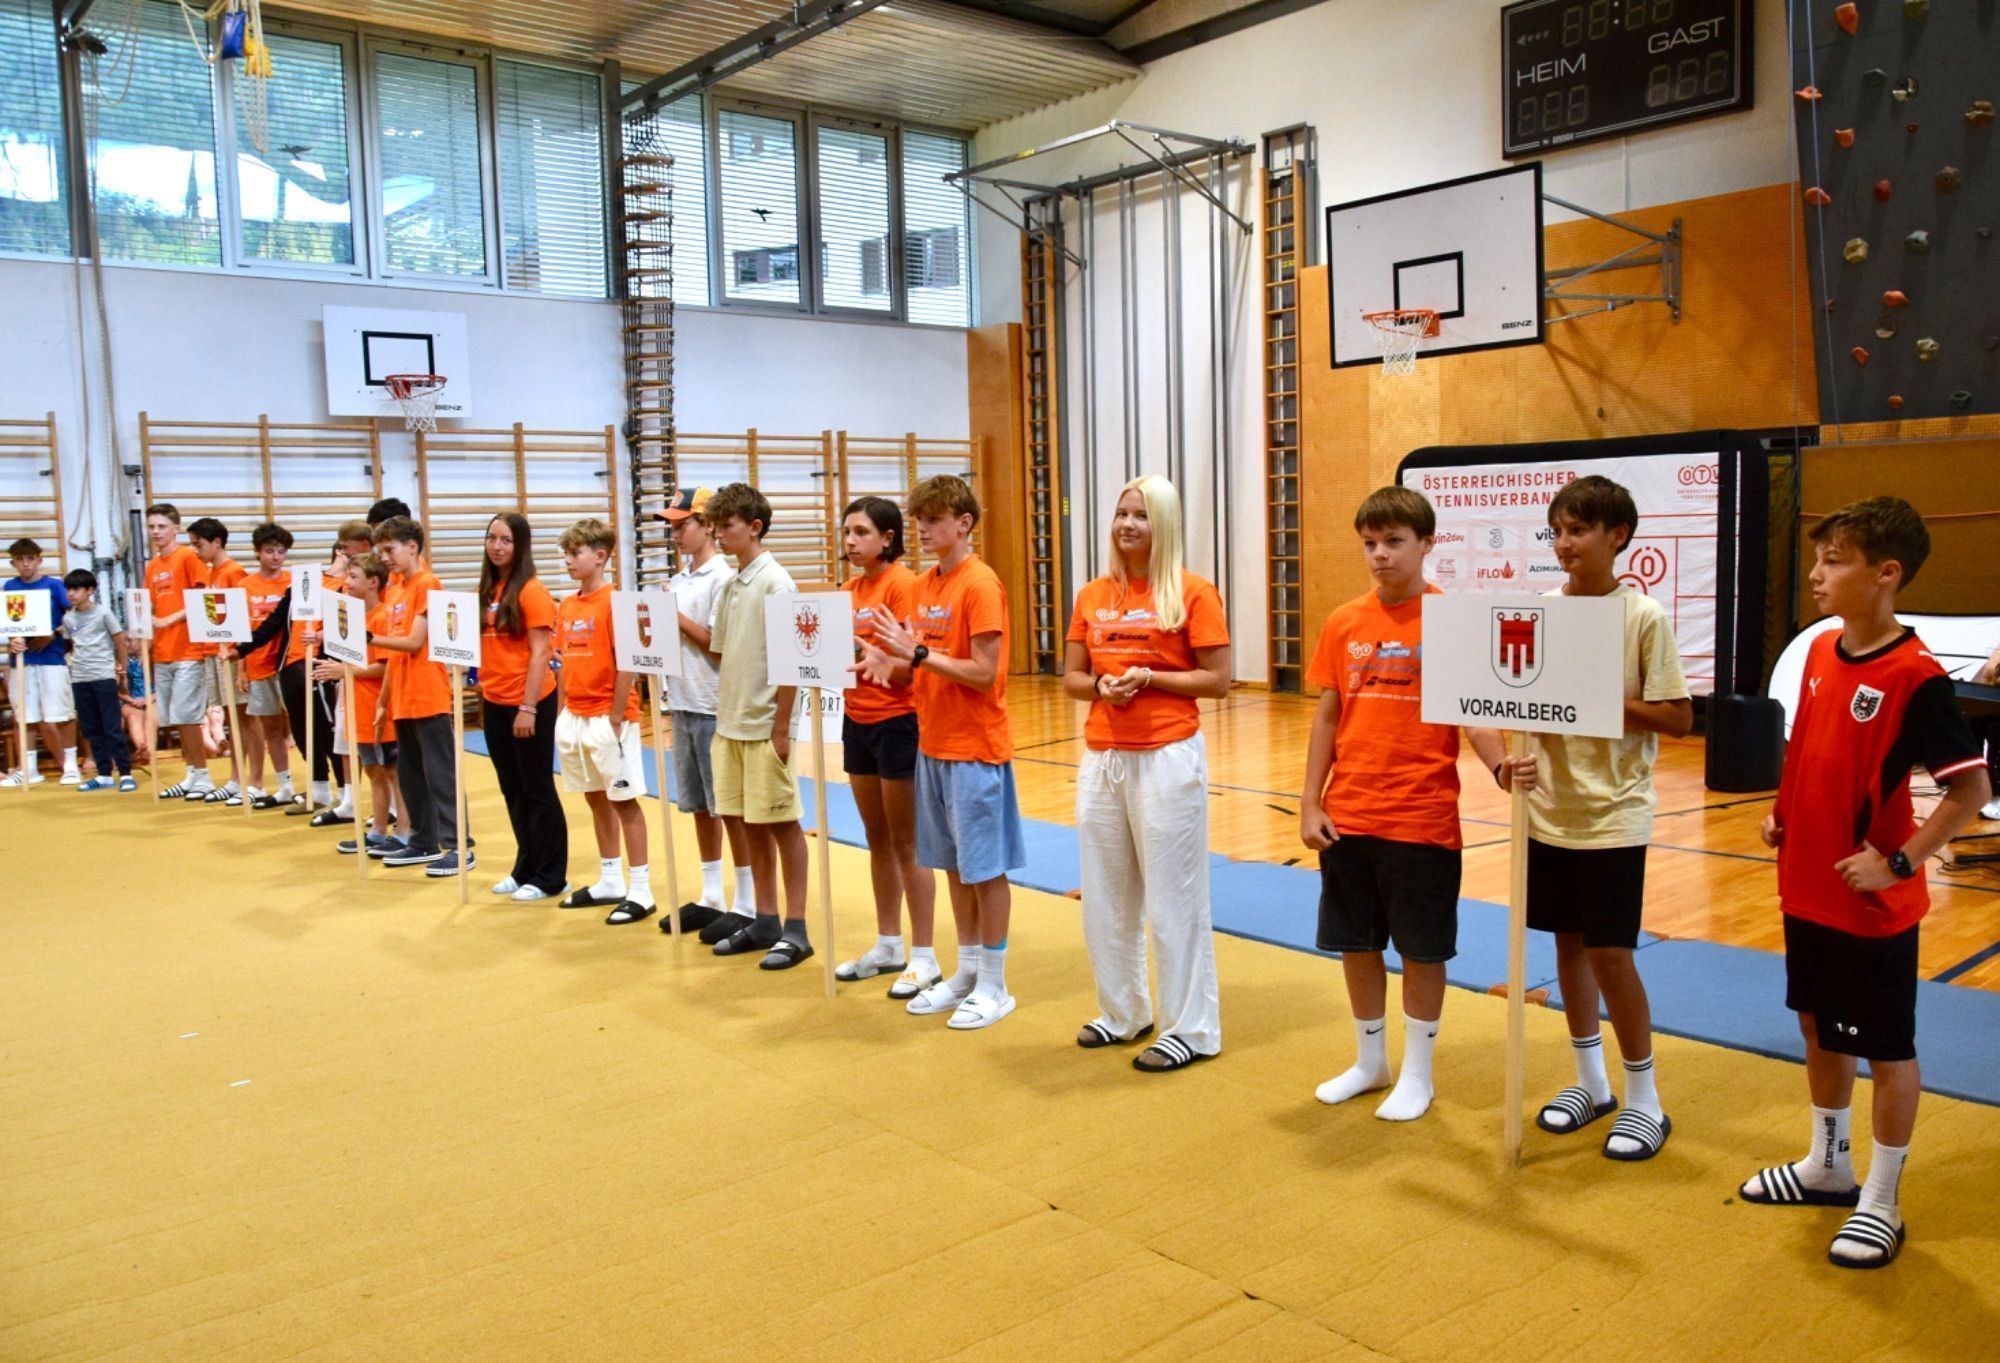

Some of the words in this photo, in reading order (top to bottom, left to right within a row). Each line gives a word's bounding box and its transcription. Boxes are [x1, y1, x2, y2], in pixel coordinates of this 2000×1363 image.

[1648, 17, 1726, 54] GAST
[1516, 53, 1587, 88] HEIM
[1502, 319, 1533, 330] BENZ
[1423, 470, 1577, 490] ÖSTERREICHISCHER
[0, 625, 38, 633] URGENLAND
[632, 655, 664, 668] SALZBURG
[798, 666, 821, 679] TIROL
[807, 696, 841, 712] SORT
[1460, 697, 1577, 723] VORARLBERG
